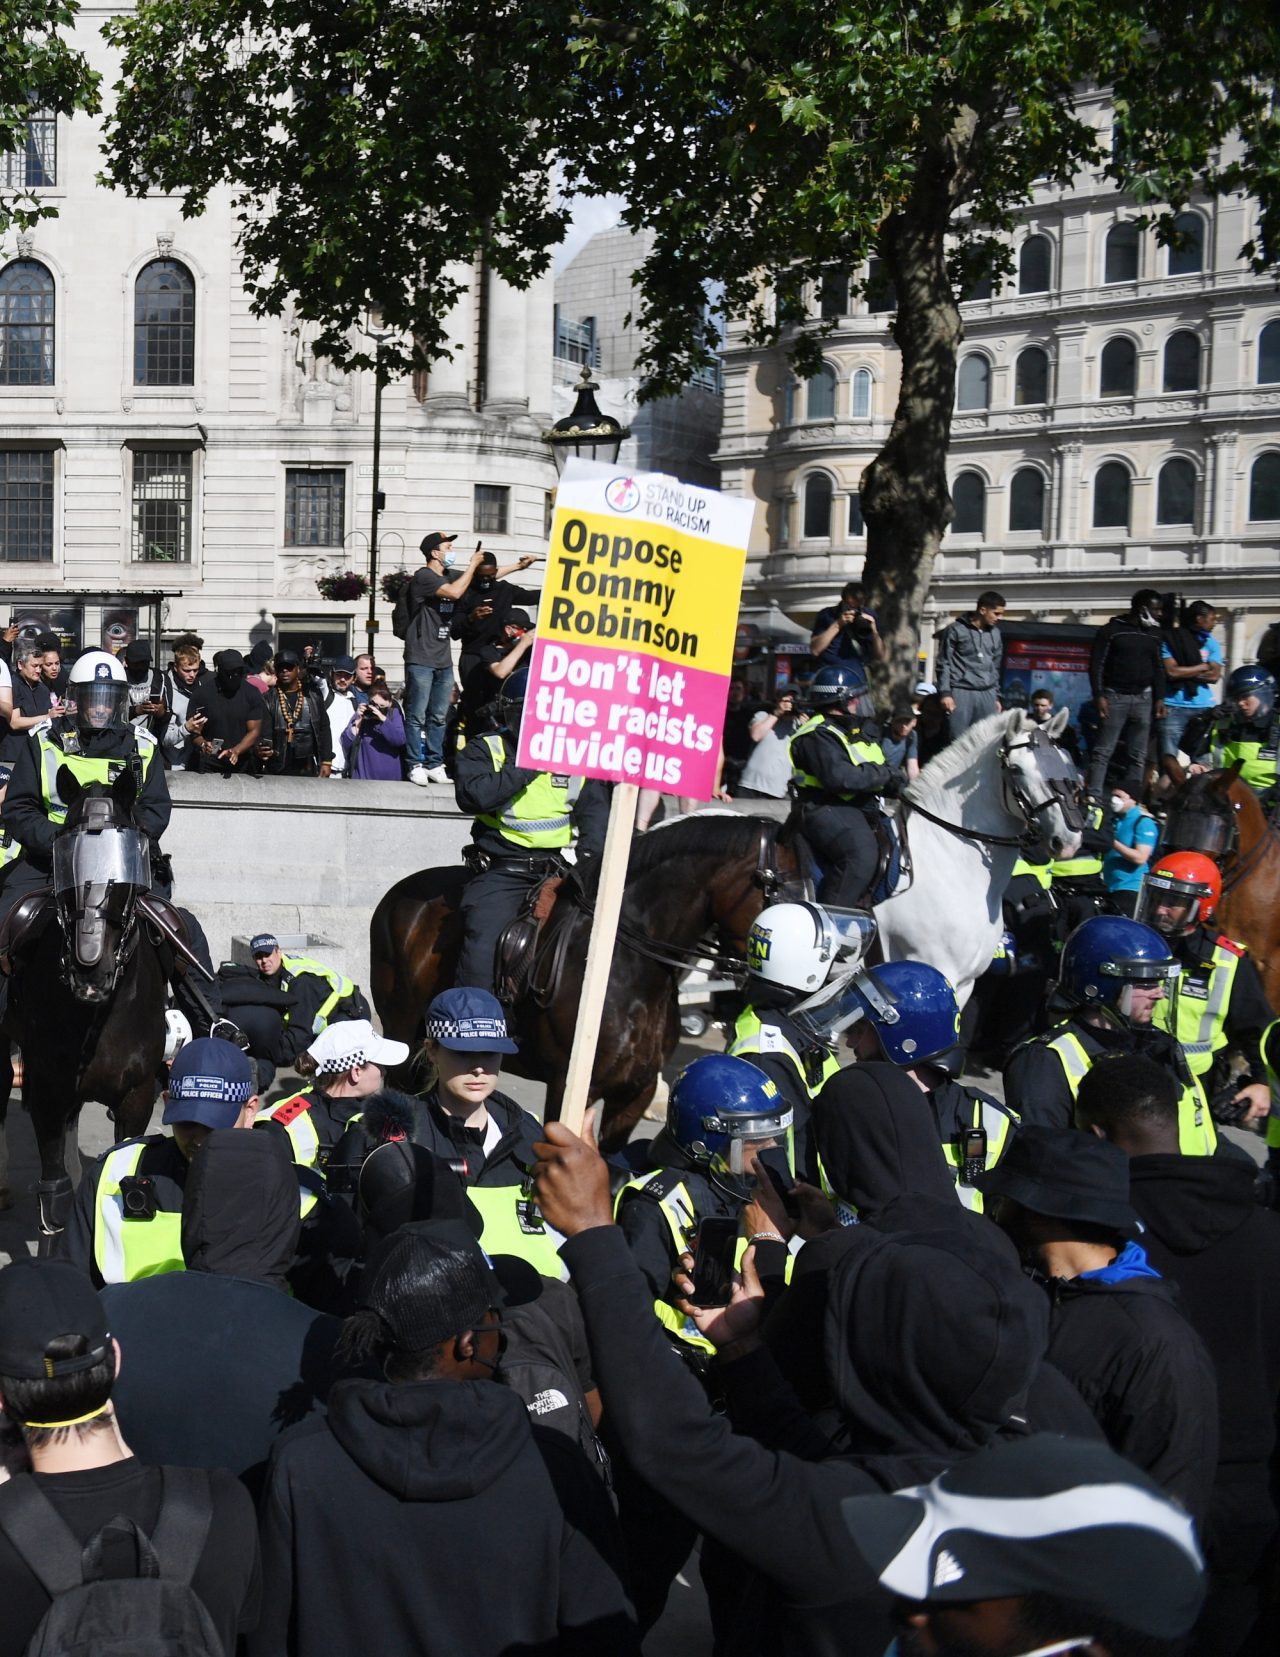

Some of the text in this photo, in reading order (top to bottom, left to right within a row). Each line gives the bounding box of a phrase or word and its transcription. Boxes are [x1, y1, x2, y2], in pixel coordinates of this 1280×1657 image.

[644, 501, 711, 534] TO RACISM
[645, 484, 706, 514] STAND UP
[562, 519, 682, 573] Oppose
[558, 558, 676, 617] Tommy
[549, 596, 699, 658] Robinson
[540, 645, 686, 706] Don't let
[536, 686, 714, 752] the racists
[530, 726, 682, 785] divide us
[200, 1091, 223, 1099] OFFICER
[527, 1398, 552, 1411] NORTH
[534, 1390, 550, 1400] THE
[537, 1403, 556, 1415] FACE
